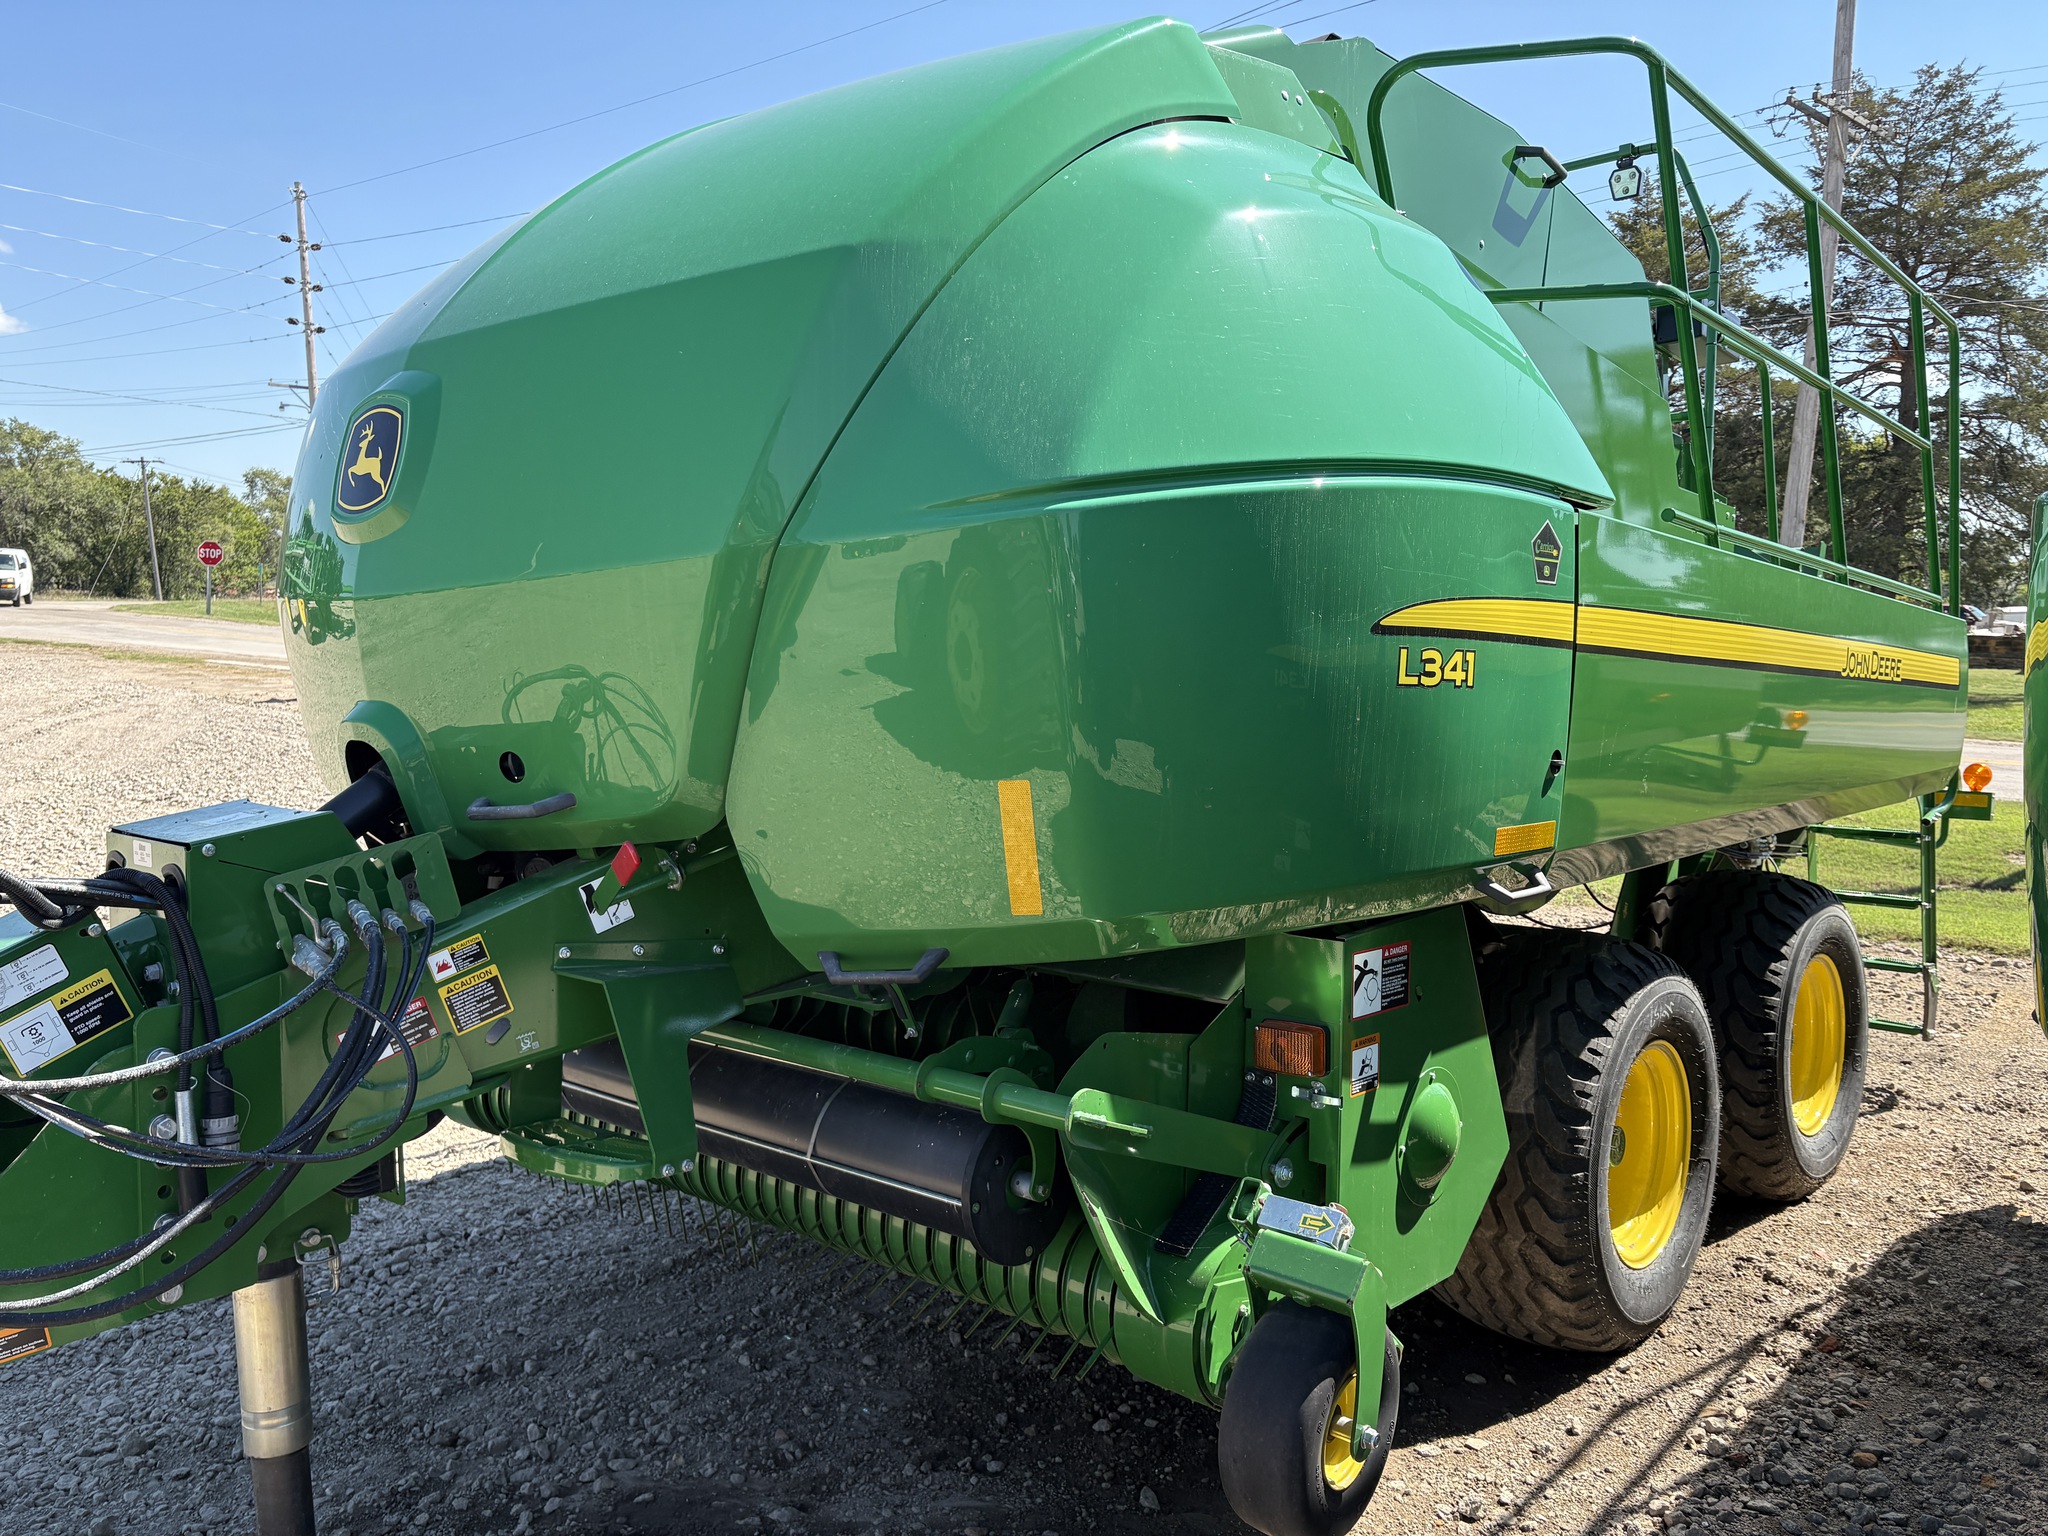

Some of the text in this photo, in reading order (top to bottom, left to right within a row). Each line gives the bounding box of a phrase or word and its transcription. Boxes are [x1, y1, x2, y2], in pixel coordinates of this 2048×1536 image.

[199, 548, 222, 559] STOP
[1397, 647, 1476, 688] L341
[1841, 647, 1902, 681] JOHN DEERE
[456, 936, 480, 950] CAUTION
[1390, 945, 1408, 955] DANGER
[453, 969, 493, 992] CAUTION
[67, 977, 105, 1000] CAUTION
[66, 1009, 80, 1018] Keep
[104, 990, 114, 998] and
[74, 1023, 86, 1032] PTO
[89, 1021, 101, 1030] RPM
[32, 1036, 46, 1047] 1000
[1358, 1036, 1377, 1046] WARNING
